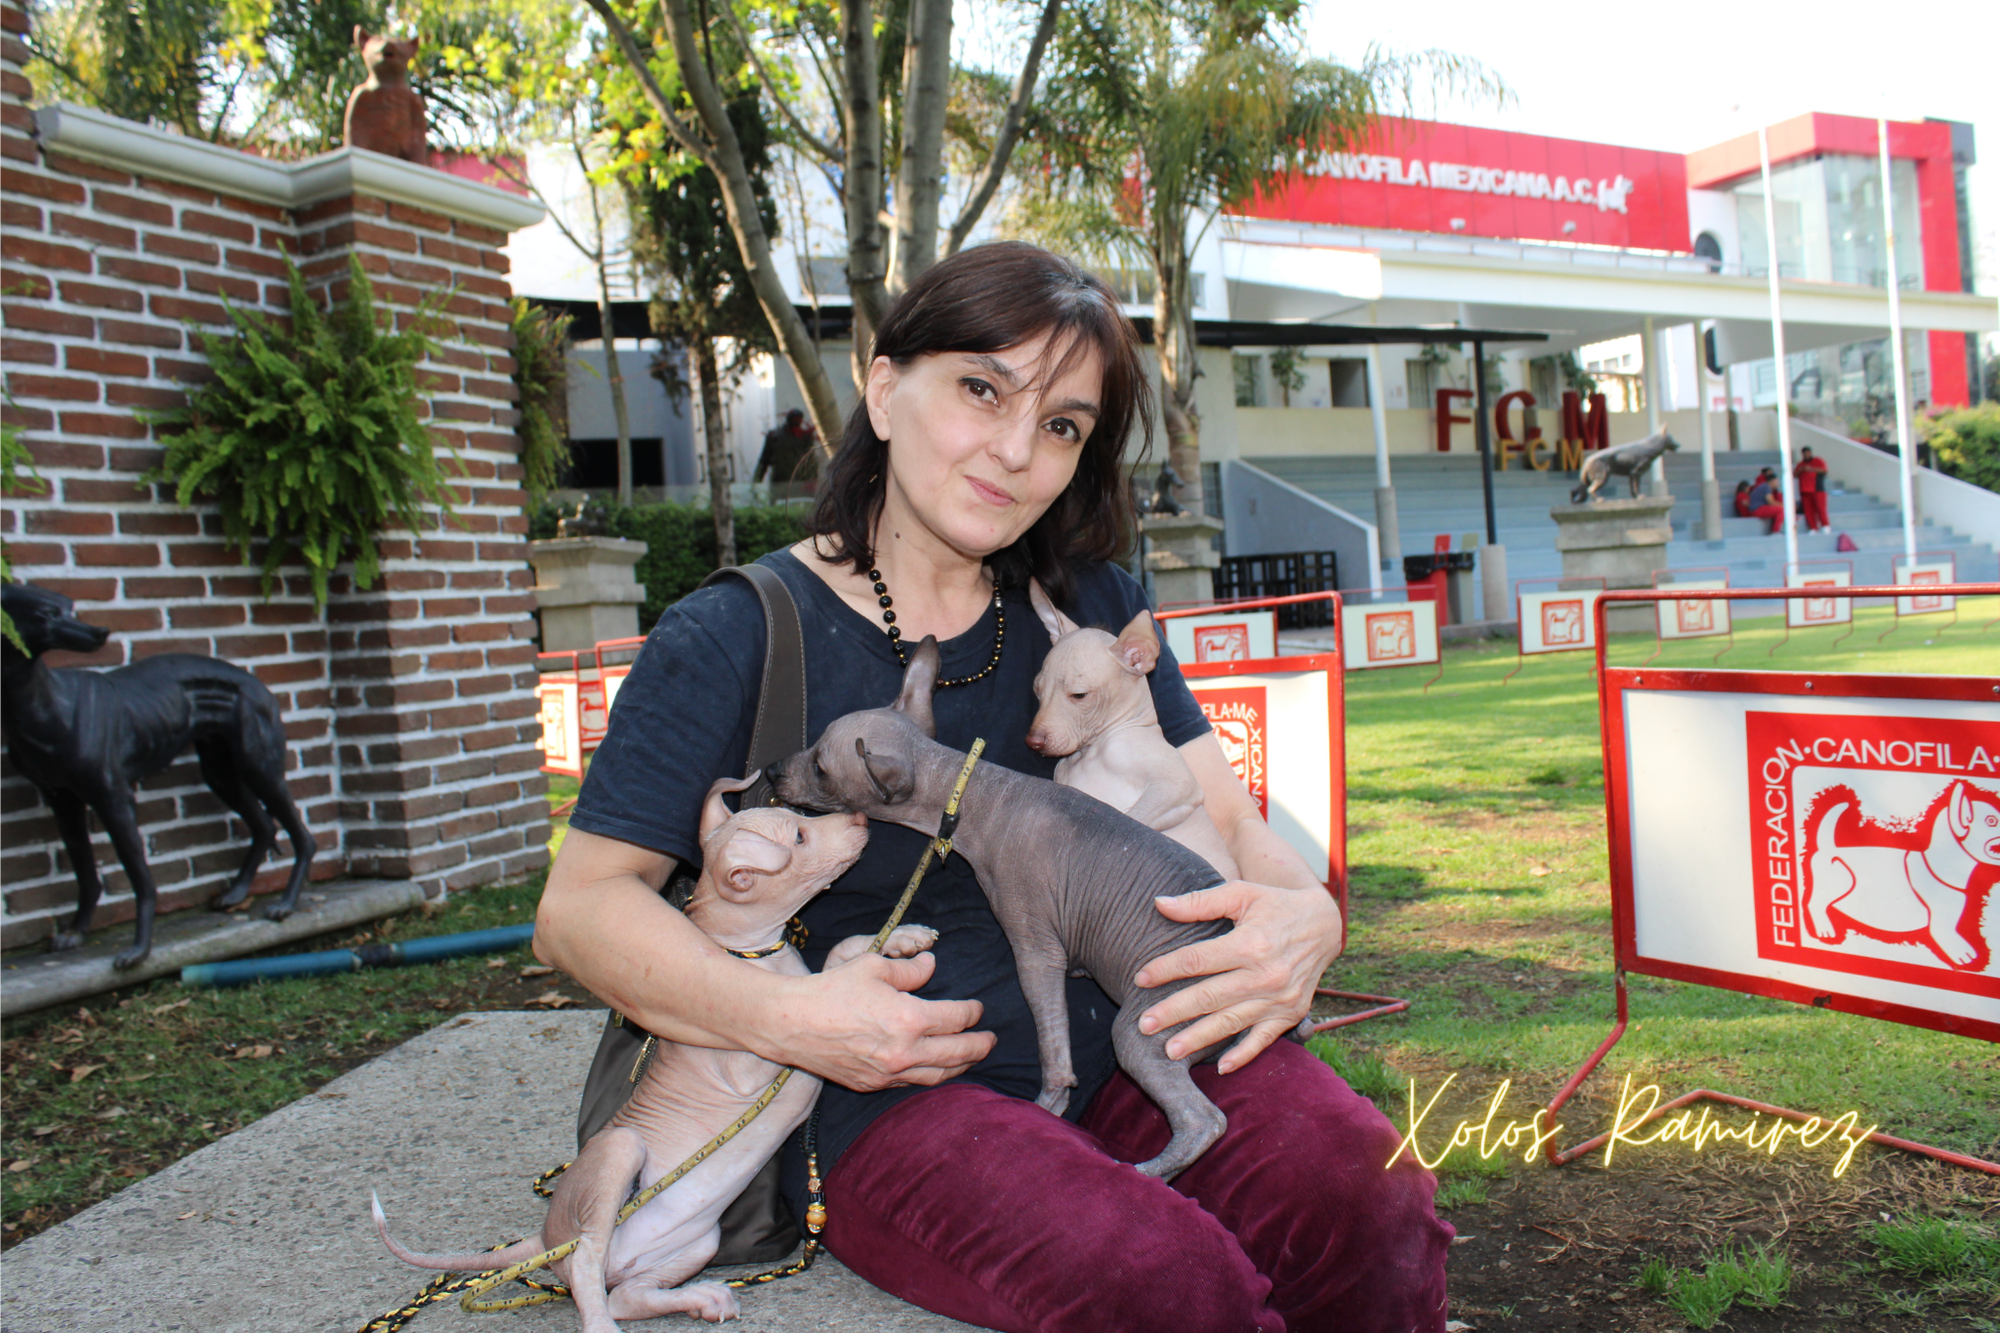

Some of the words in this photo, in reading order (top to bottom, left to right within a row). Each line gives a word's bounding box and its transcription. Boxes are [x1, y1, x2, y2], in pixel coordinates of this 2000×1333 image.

[1429, 161, 1553, 200] MEXICANA
[1554, 175, 1598, 204] A.C.
[1497, 438, 1584, 471] FCM
[1202, 703, 1230, 719] FILA
[1762, 738, 1805, 948] FEDERACION
[1812, 737, 1995, 772] CANOFILA
